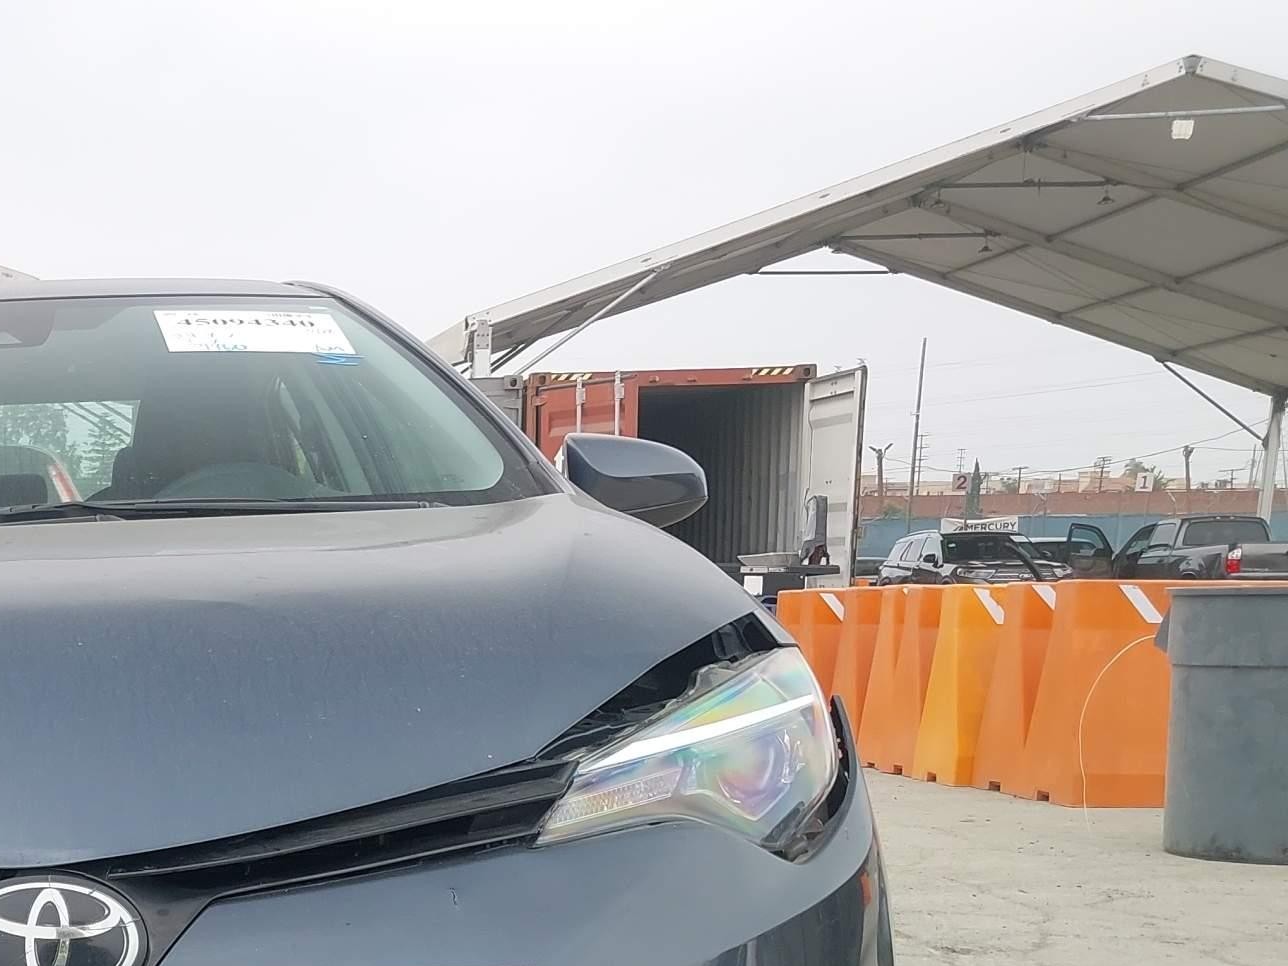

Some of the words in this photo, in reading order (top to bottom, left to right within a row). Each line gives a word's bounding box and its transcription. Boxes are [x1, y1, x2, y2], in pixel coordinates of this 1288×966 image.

[956, 475, 968, 489] 2
[1139, 475, 1149, 489] 1
[965, 521, 1017, 532] MERCURY
